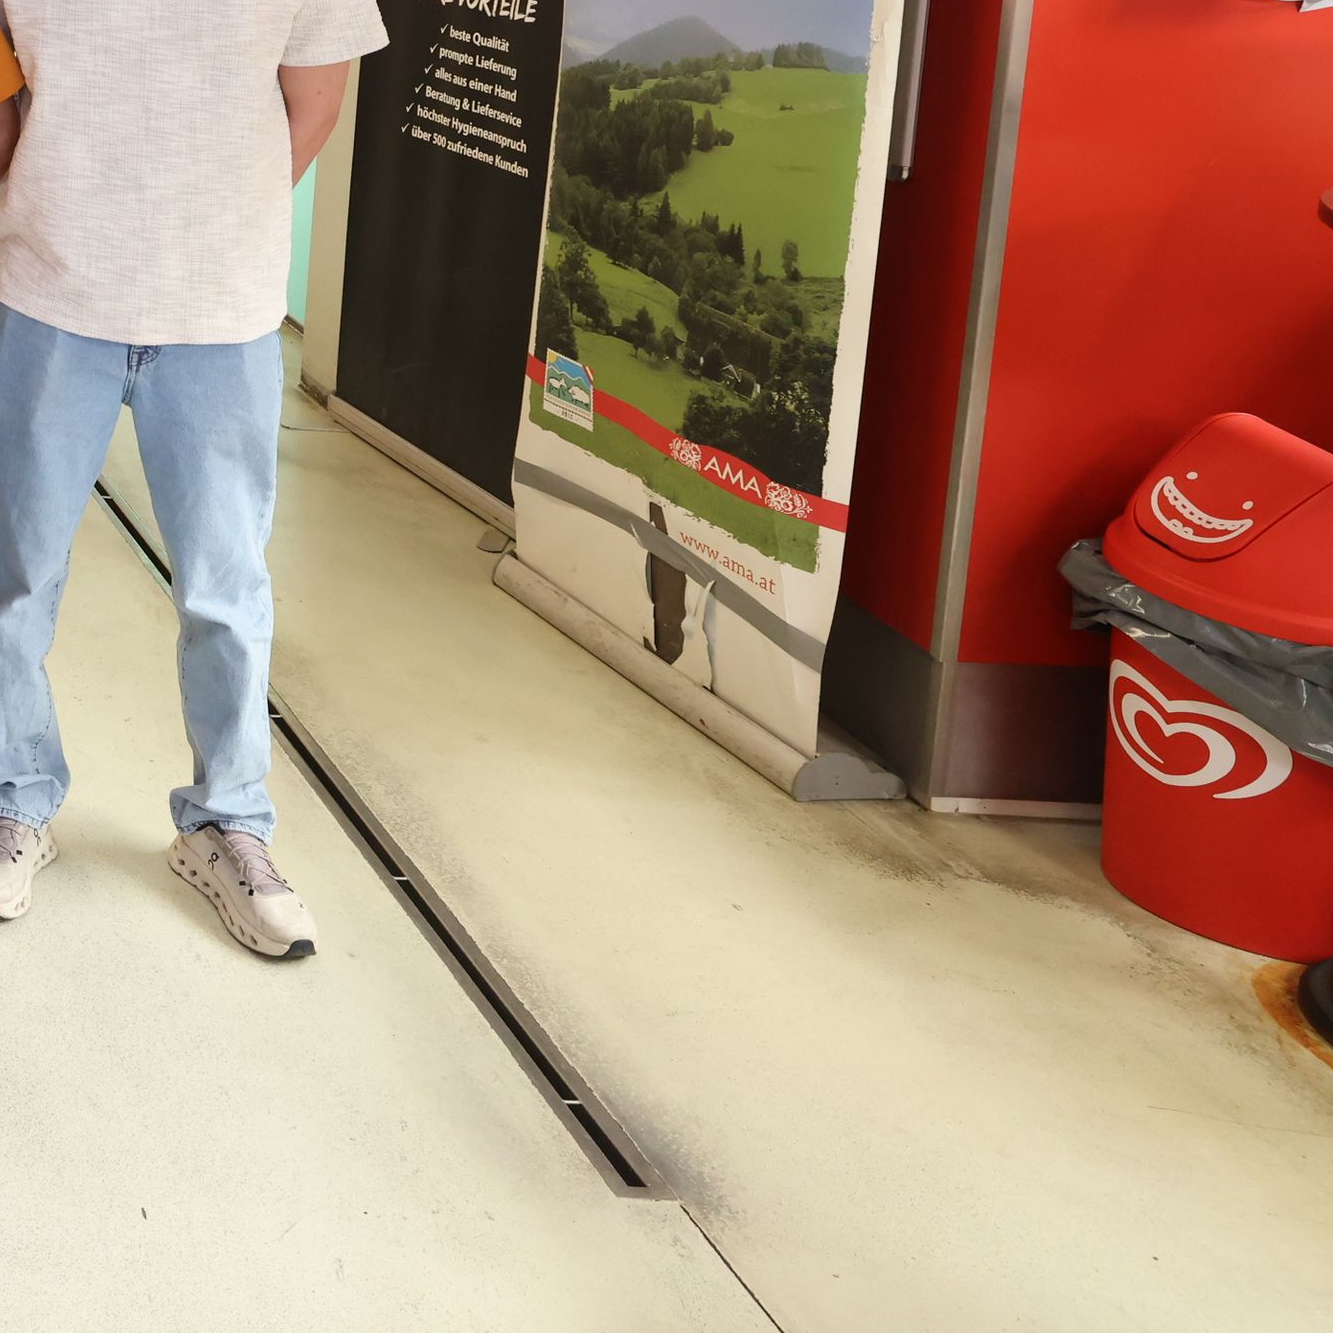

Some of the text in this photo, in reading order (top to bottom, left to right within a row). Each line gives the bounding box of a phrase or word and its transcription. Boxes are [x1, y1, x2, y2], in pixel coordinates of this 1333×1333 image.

[449, 25, 510, 52] beste Qualität
[439, 46, 517, 81] prompte Lieferung
[425, 85, 461, 111] Beratung
[462, 97, 470, 111] &
[434, 67, 517, 102] alles aus einer Hand
[417, 104, 527, 154] höchster Hygieneanspruch
[411, 125, 529, 178] über 500 zufriedene Kunden
[704, 456, 763, 499] AMA
[679, 531, 776, 595] www.ama.at
